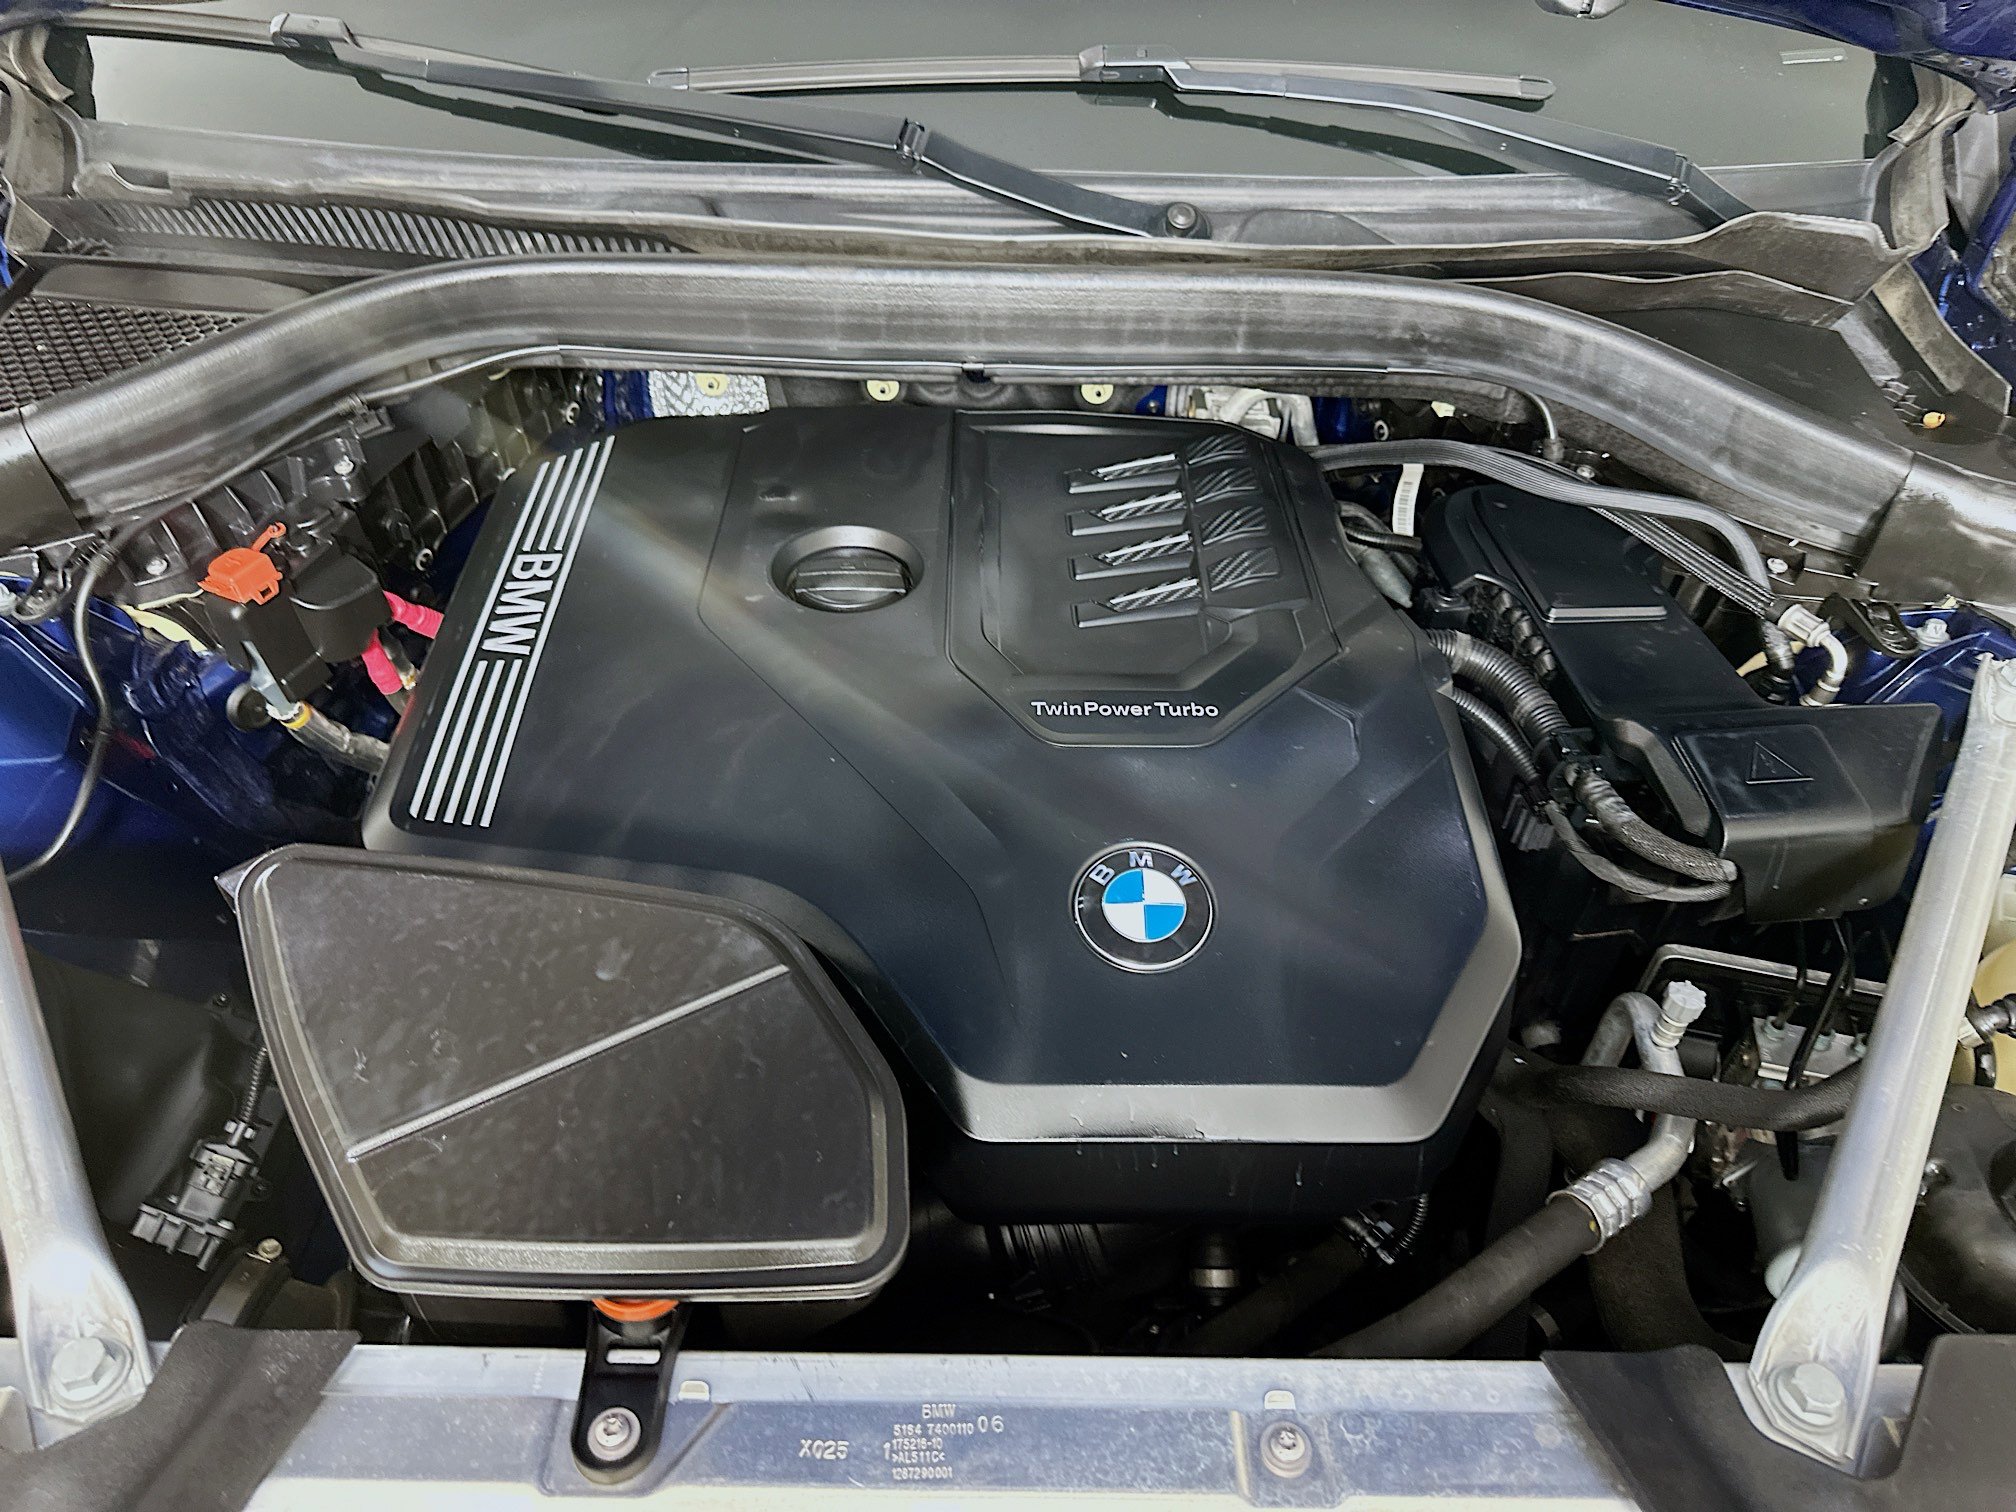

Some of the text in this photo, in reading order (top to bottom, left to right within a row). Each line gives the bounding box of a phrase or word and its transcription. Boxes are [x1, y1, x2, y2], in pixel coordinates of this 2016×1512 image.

[481, 553, 563, 655] BMW
[1031, 701, 1219, 717] TwinPower Turbo
[1088, 851, 1198, 886] BMW
[921, 1403, 957, 1419] BMW
[977, 1415, 1004, 1433] 06
